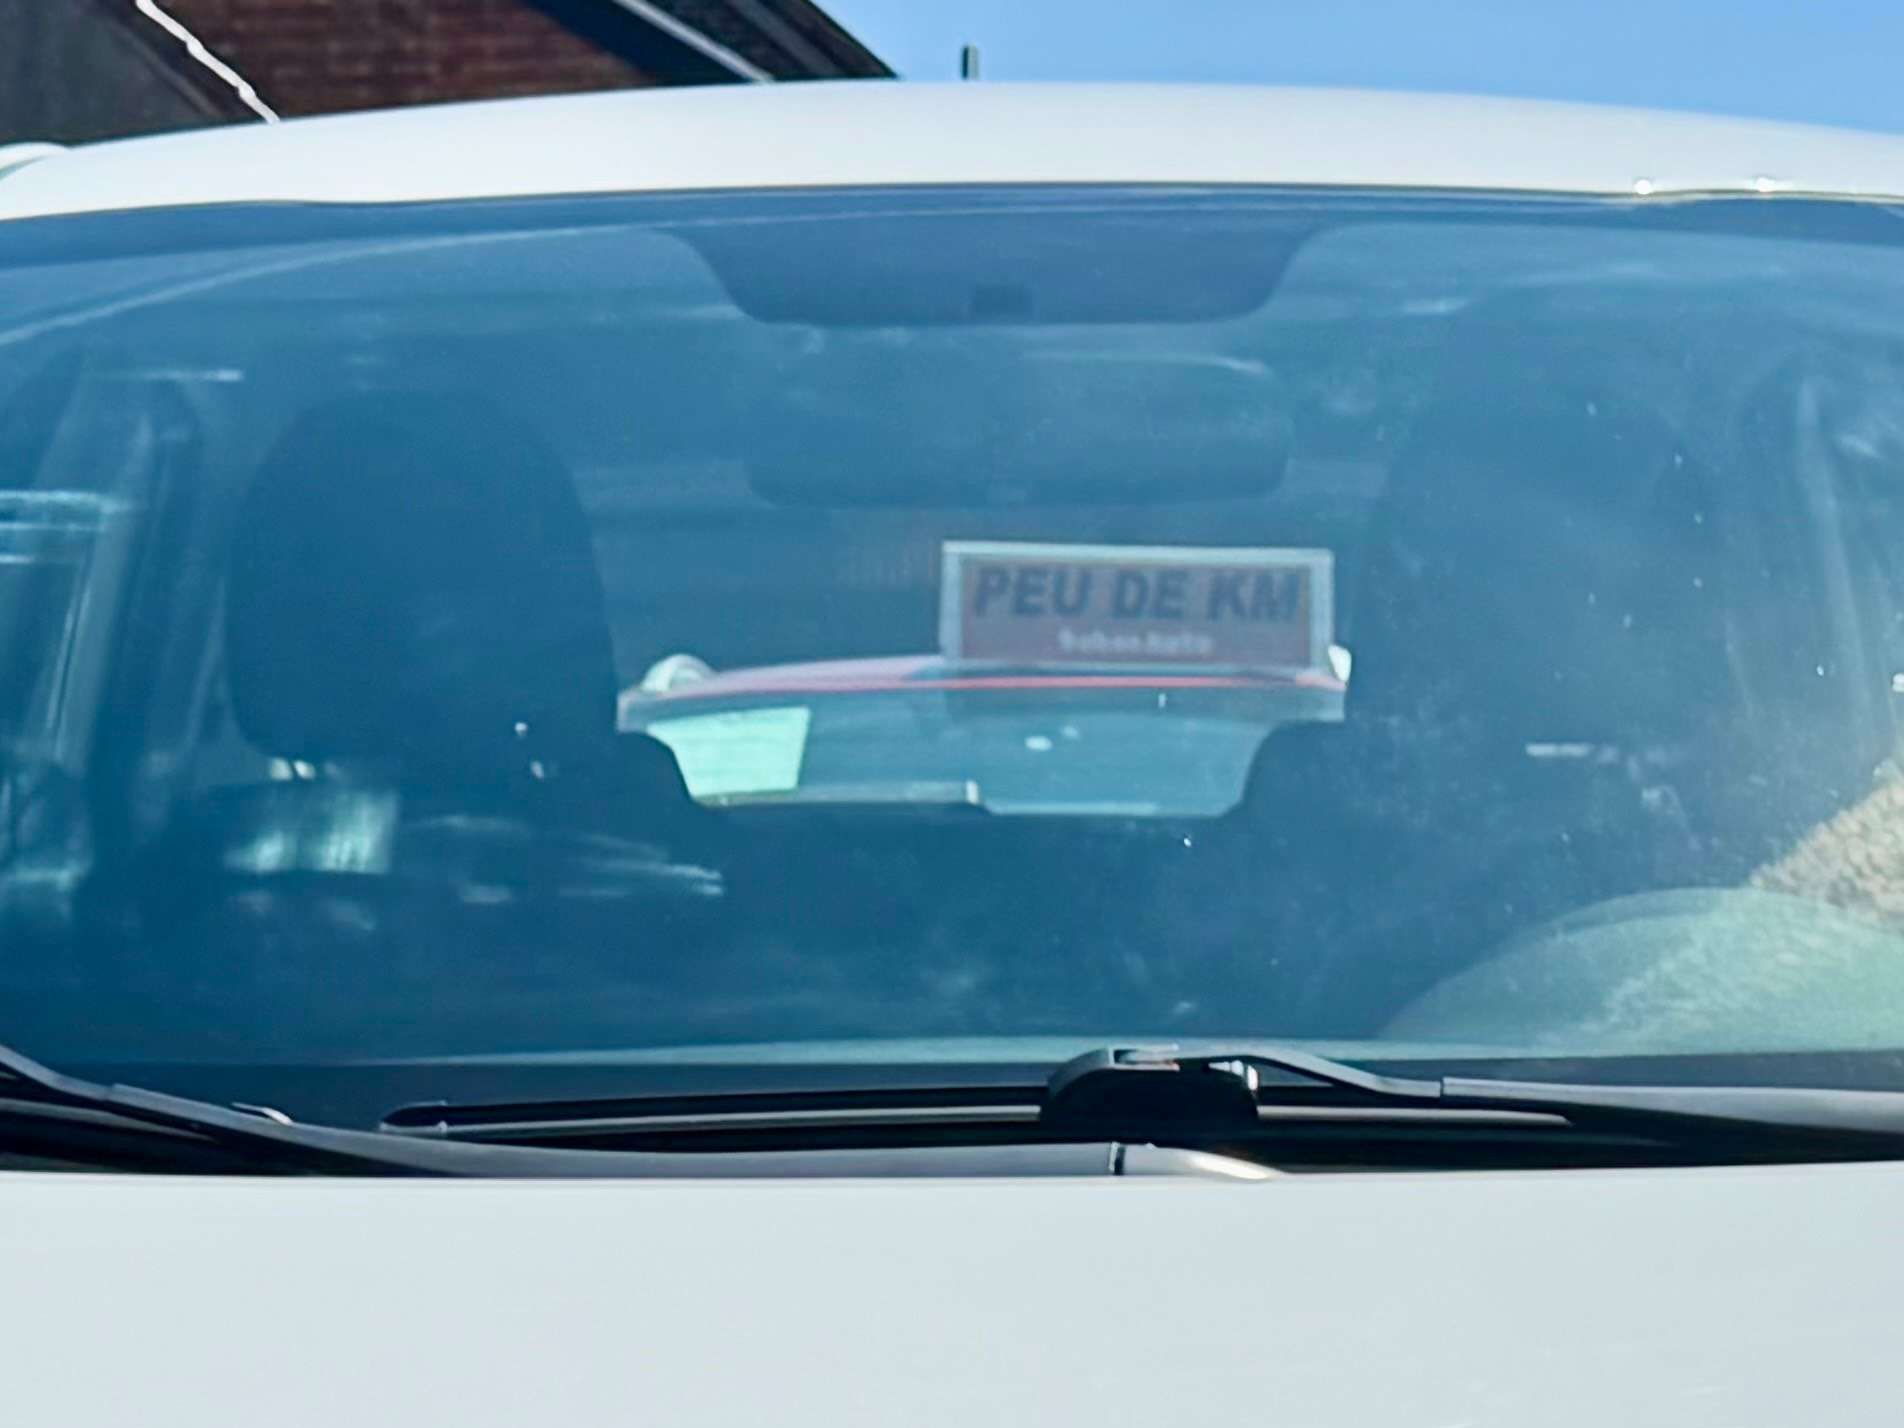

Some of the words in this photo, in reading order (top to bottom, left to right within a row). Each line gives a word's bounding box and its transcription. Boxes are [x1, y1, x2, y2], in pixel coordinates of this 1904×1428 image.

[974, 566, 1092, 617] PEU
[1112, 568, 1188, 620] DE
[1207, 569, 1302, 621] KM
